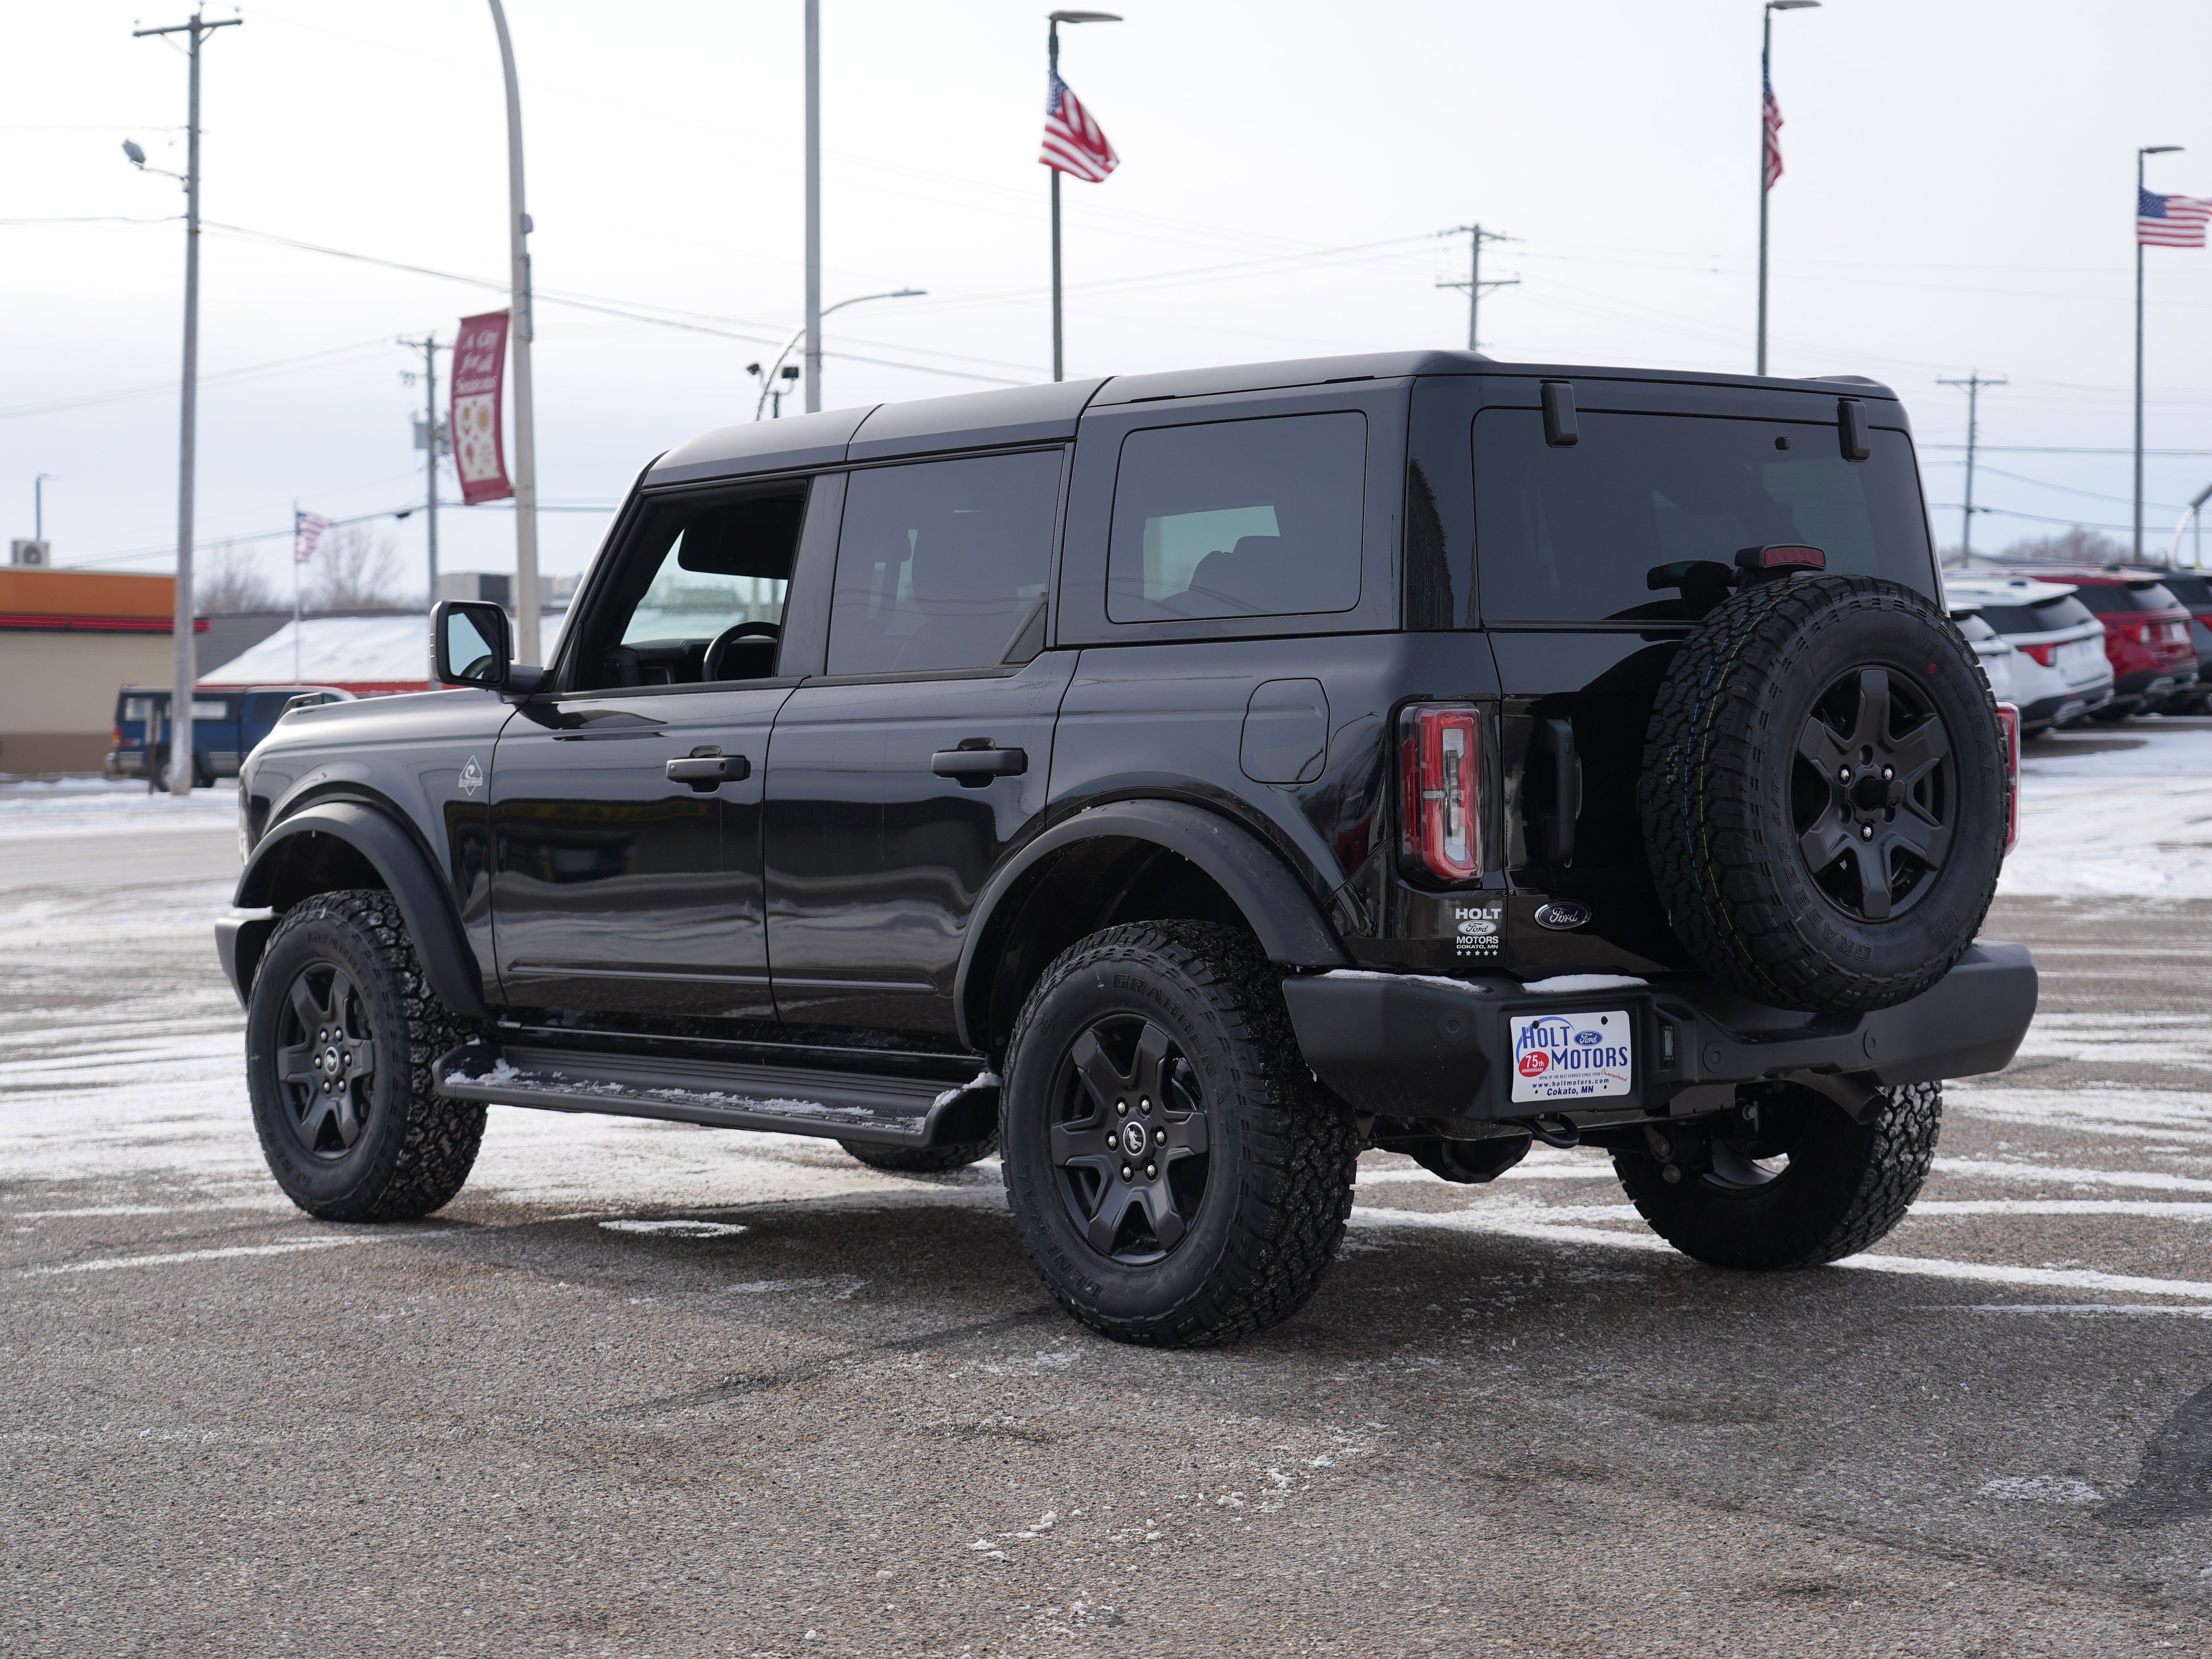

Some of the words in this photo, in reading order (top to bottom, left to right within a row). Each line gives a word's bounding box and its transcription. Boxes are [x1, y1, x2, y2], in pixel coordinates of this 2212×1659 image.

[462, 333, 475, 349] A
[477, 329, 500, 351] City
[457, 352, 481, 375] for
[477, 353, 494, 373] all
[455, 375, 497, 393] Seasons
[1919, 637, 1995, 787] GENERAL
[1777, 840, 1873, 962] GRABBER
[1455, 908, 1501, 920] HOLT
[1549, 907, 1578, 923] Ford
[1466, 922, 1488, 932] Ford
[1456, 936, 1499, 944] MOTORS
[1112, 974, 1216, 1077] GRABBER
[1522, 1026, 1570, 1049] HOLT
[1579, 1033, 1597, 1044] Ford
[1525, 1055, 1544, 1068] 75th
[1552, 1047, 1628, 1071] MOTORS
[1533, 1078, 1609, 1088] www.holtmotors.com
[1601, 1069, 1628, 1082] Guaranteed
[1547, 1087, 1578, 1096] Cokato,
[1581, 1085, 1594, 1094] MN
[1017, 1163, 1104, 1299] GENERAL
